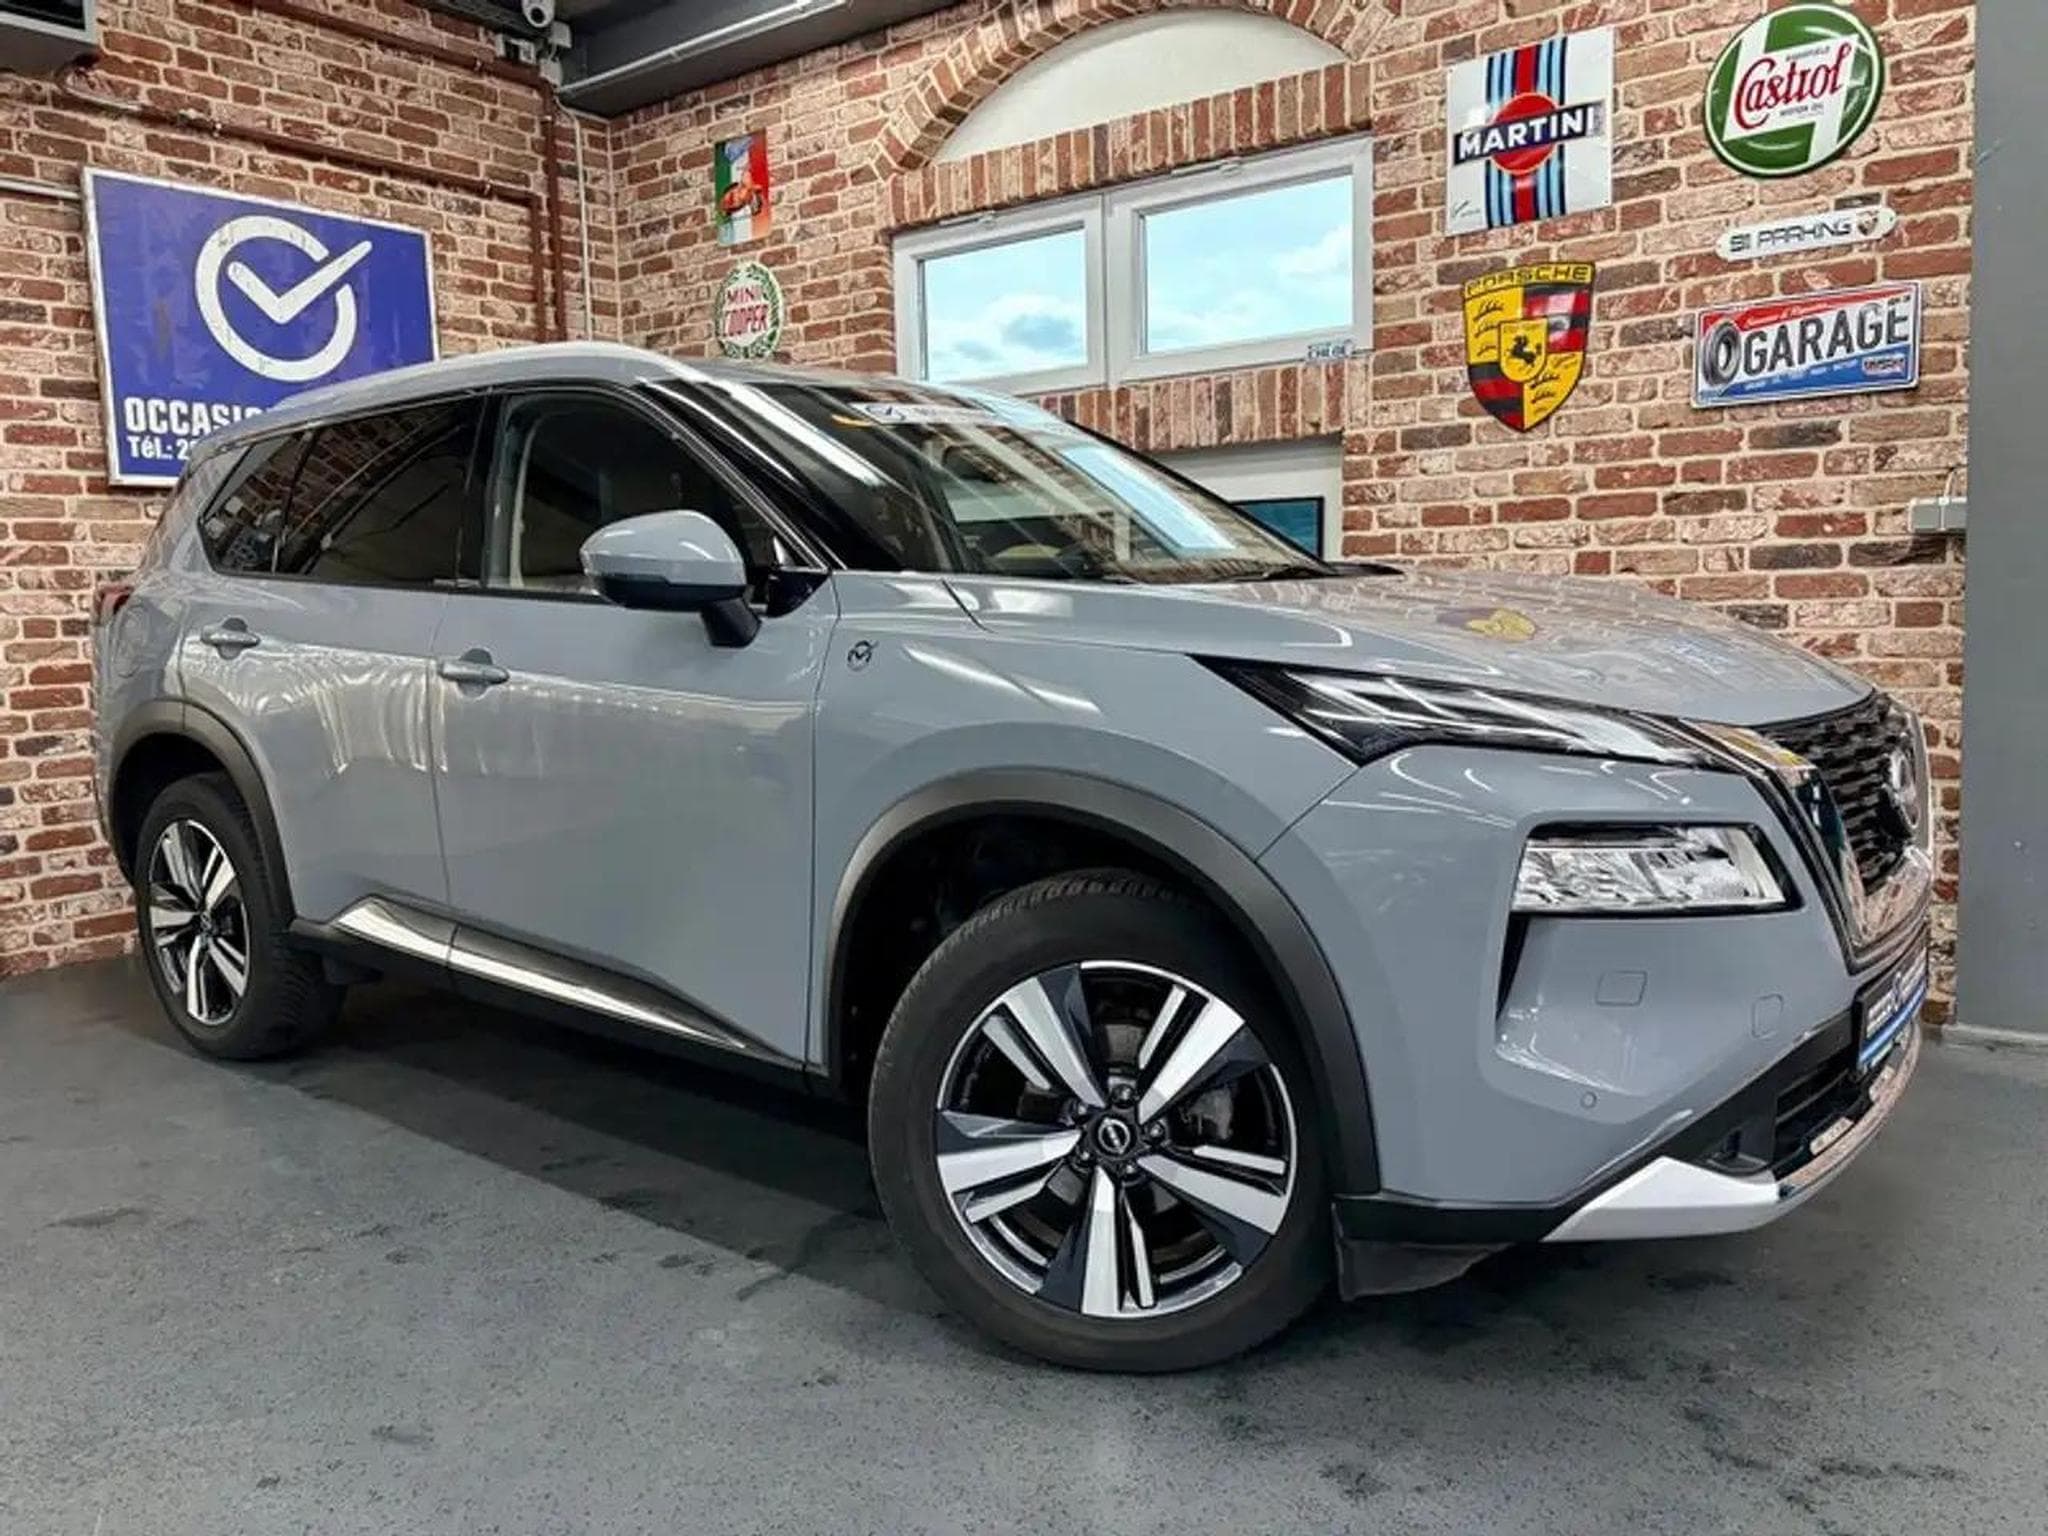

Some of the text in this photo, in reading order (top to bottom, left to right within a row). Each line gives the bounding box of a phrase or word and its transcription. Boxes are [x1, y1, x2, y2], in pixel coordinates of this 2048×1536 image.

[1734, 42, 1852, 130] Castrol
[1458, 106, 1595, 160] MARTINI
[1466, 265, 1589, 296] PORSCHE
[1743, 295, 1910, 377] GARAGE
[175, 438, 199, 461] 2
